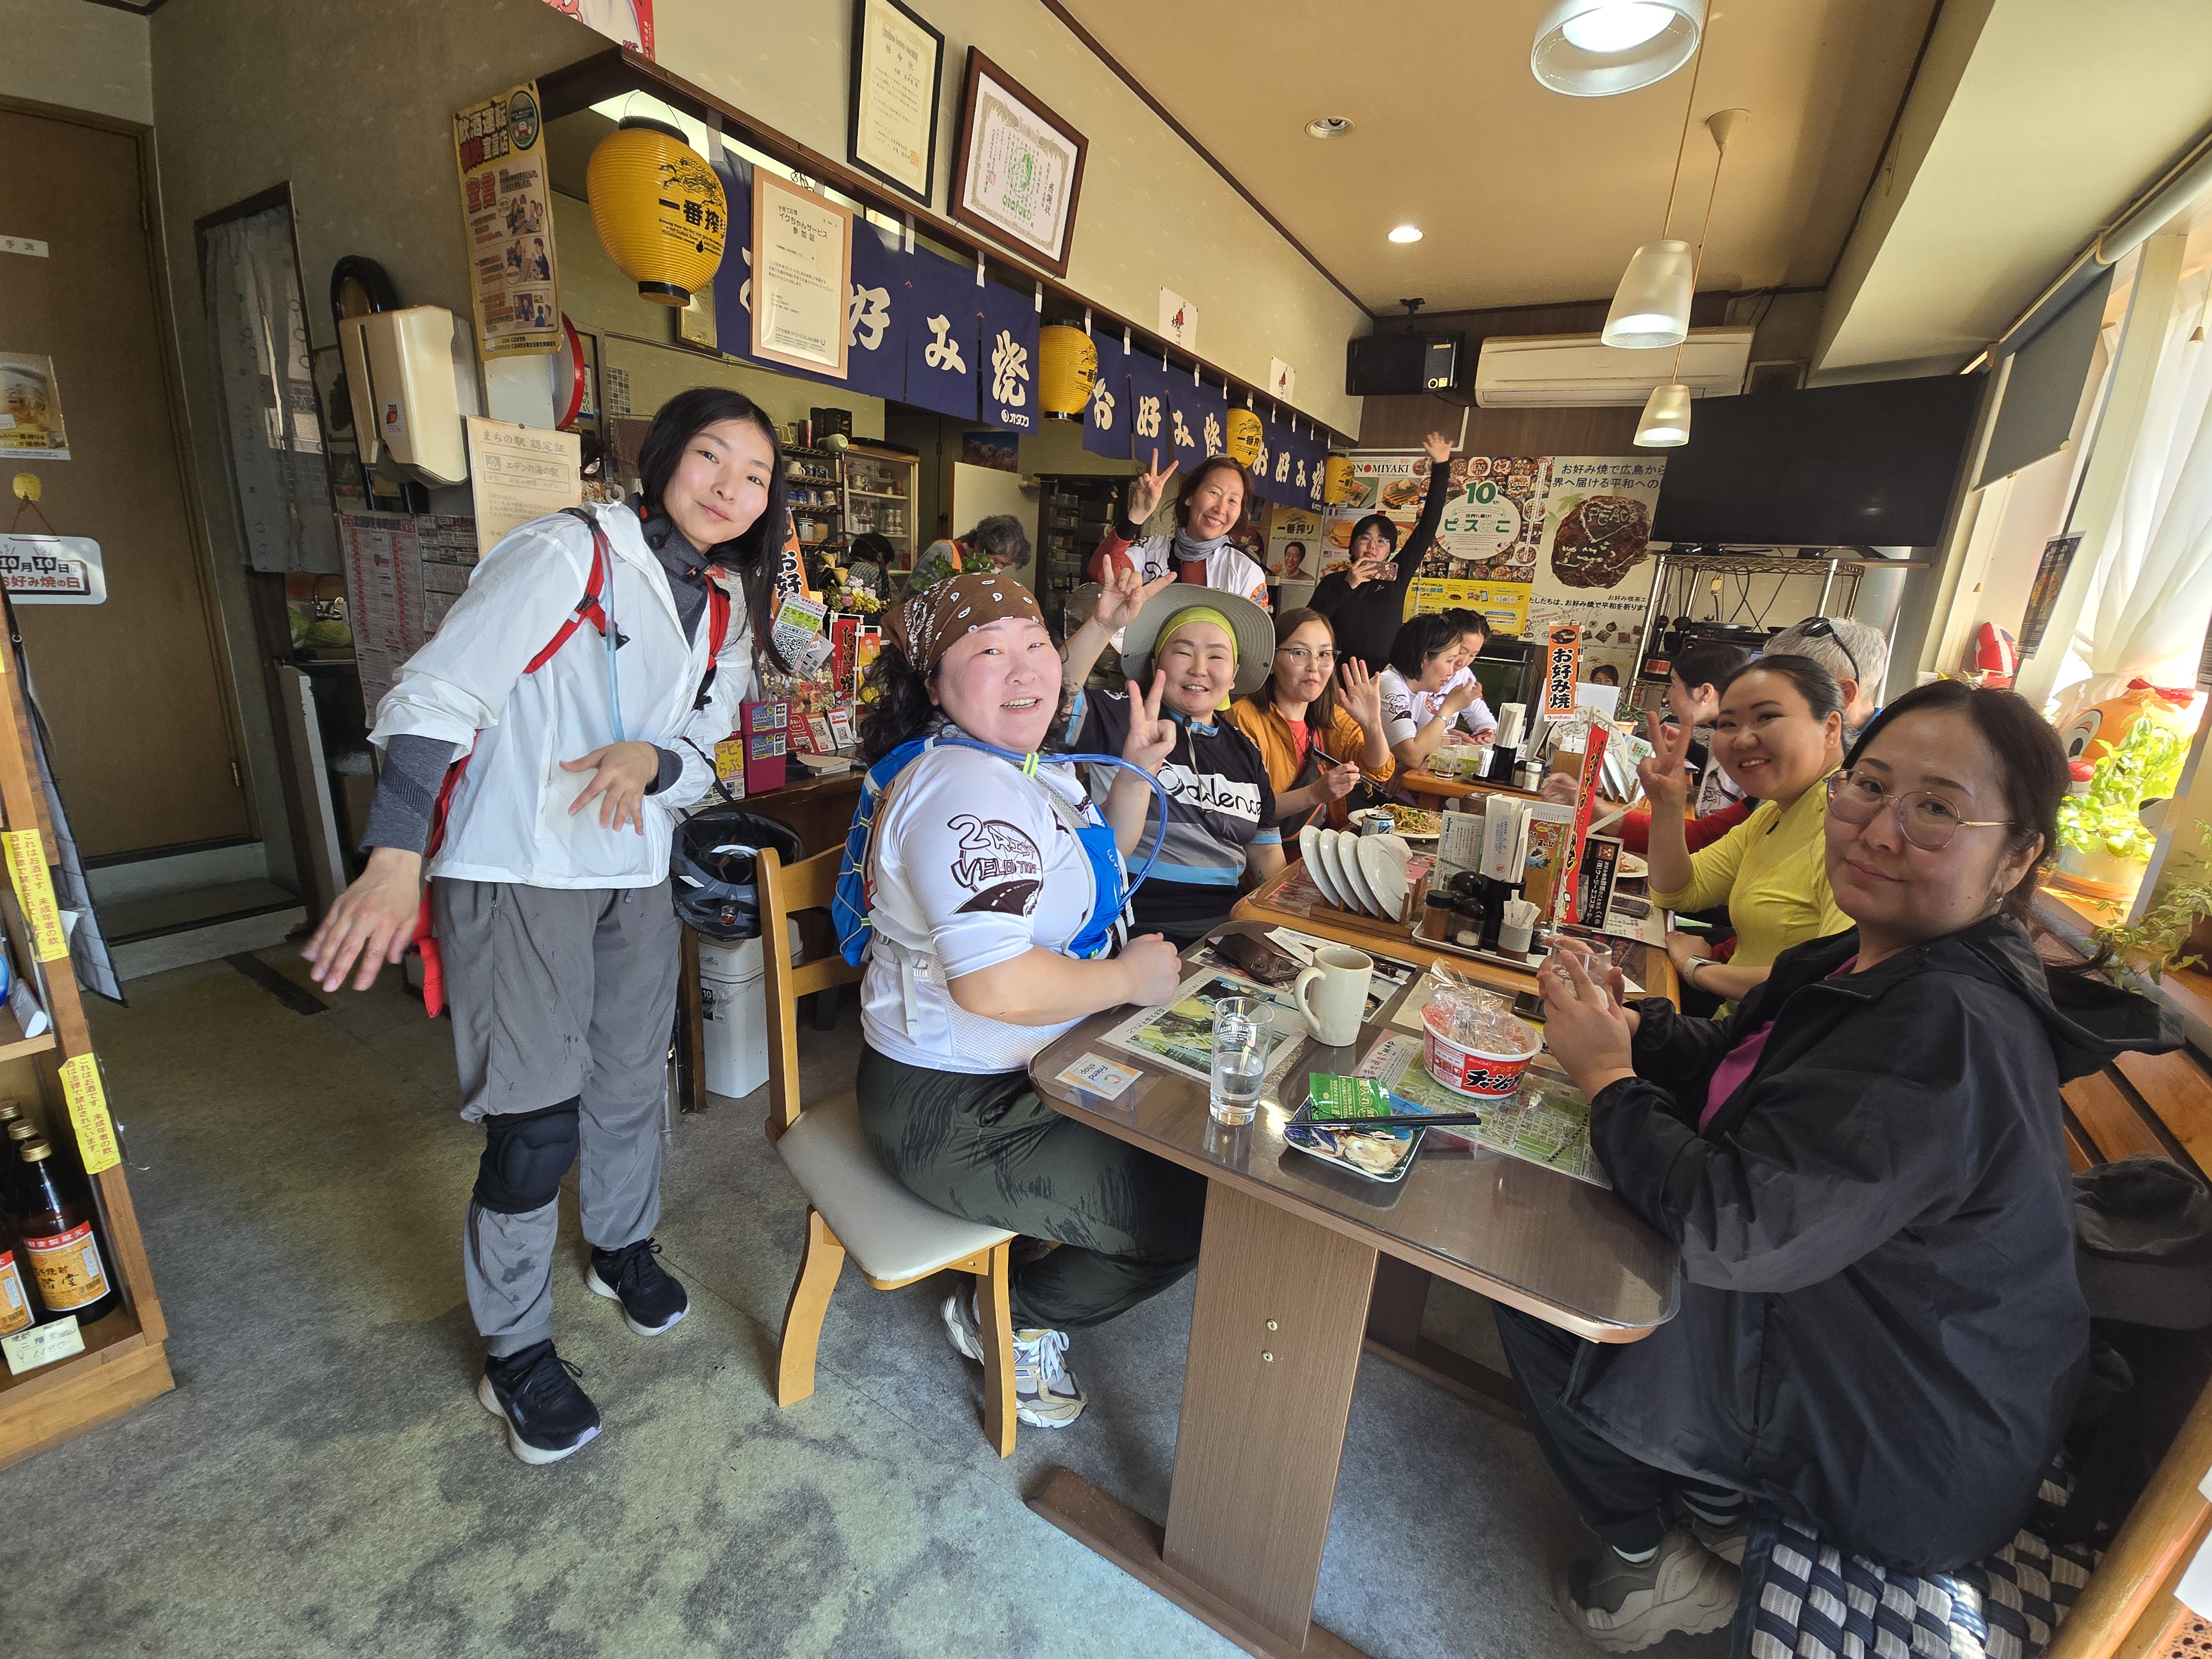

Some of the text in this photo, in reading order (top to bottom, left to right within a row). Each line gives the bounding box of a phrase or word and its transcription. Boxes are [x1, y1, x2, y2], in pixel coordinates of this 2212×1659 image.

[885, 44, 913, 71] 任命状
[458, 100, 507, 145] 飲酒運転
[465, 171, 496, 215] 宣言
[1044, 182, 1054, 216] 感謝状
[779, 213, 828, 239] イクちゃんサービス
[793, 227, 815, 242] 参加証
[1009, 413, 1030, 427] オタフク
[483, 429, 565, 453] まちの駅 認定証
[505, 462, 560, 479] エデンの海の駅
[1465, 482, 1496, 504] 10
[1277, 524, 1314, 535] 一番搾り
[1444, 518, 1511, 533] ピースおこ
[781, 624, 808, 637] お好み喫茶エデン
[1548, 648, 1573, 710] お好み焼
[1156, 762, 1262, 816] Cadence
[950, 857, 1017, 889] VELO
[1079, 1062, 1096, 1076] shop
[1362, 1051, 1387, 1075] まちあるき
[1382, 1041, 1396, 1053] MAP
[1087, 1065, 1109, 1082] Friend
